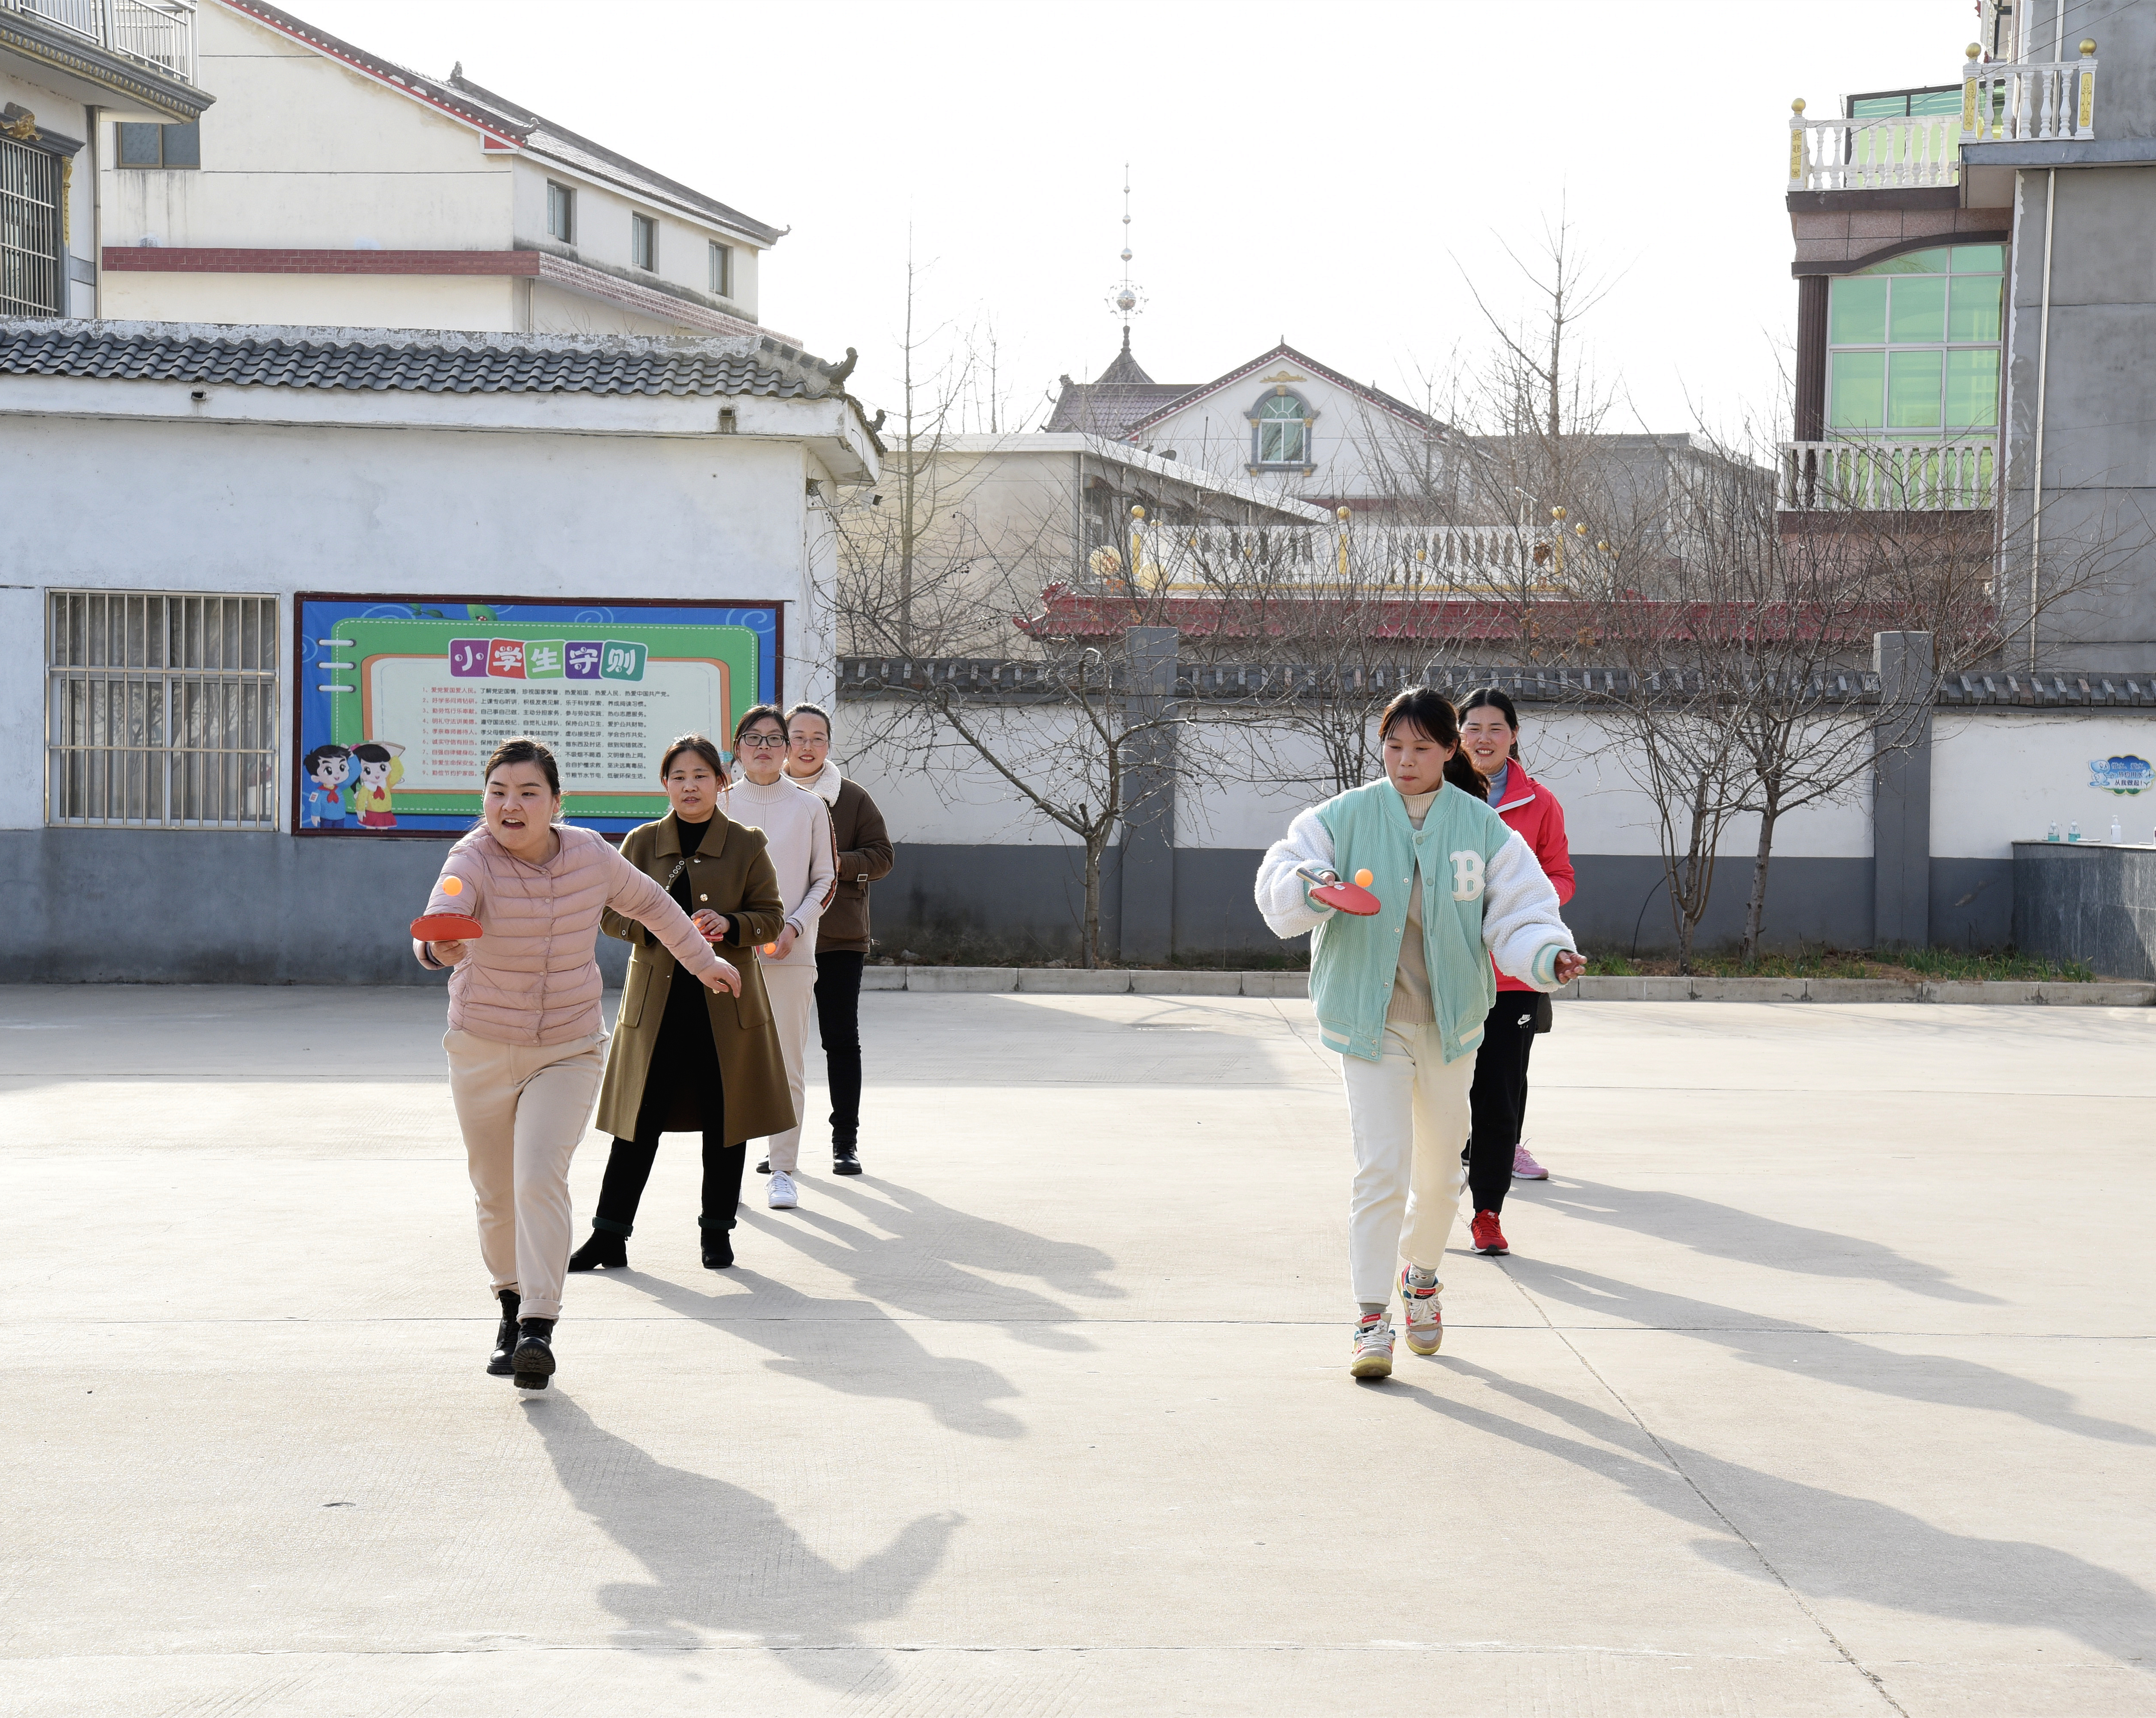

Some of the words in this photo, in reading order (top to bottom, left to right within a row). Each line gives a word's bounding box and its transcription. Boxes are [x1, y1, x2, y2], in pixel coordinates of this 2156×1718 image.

[455, 646, 636, 675] 小学生守则
[1449, 850, 1486, 901] B
